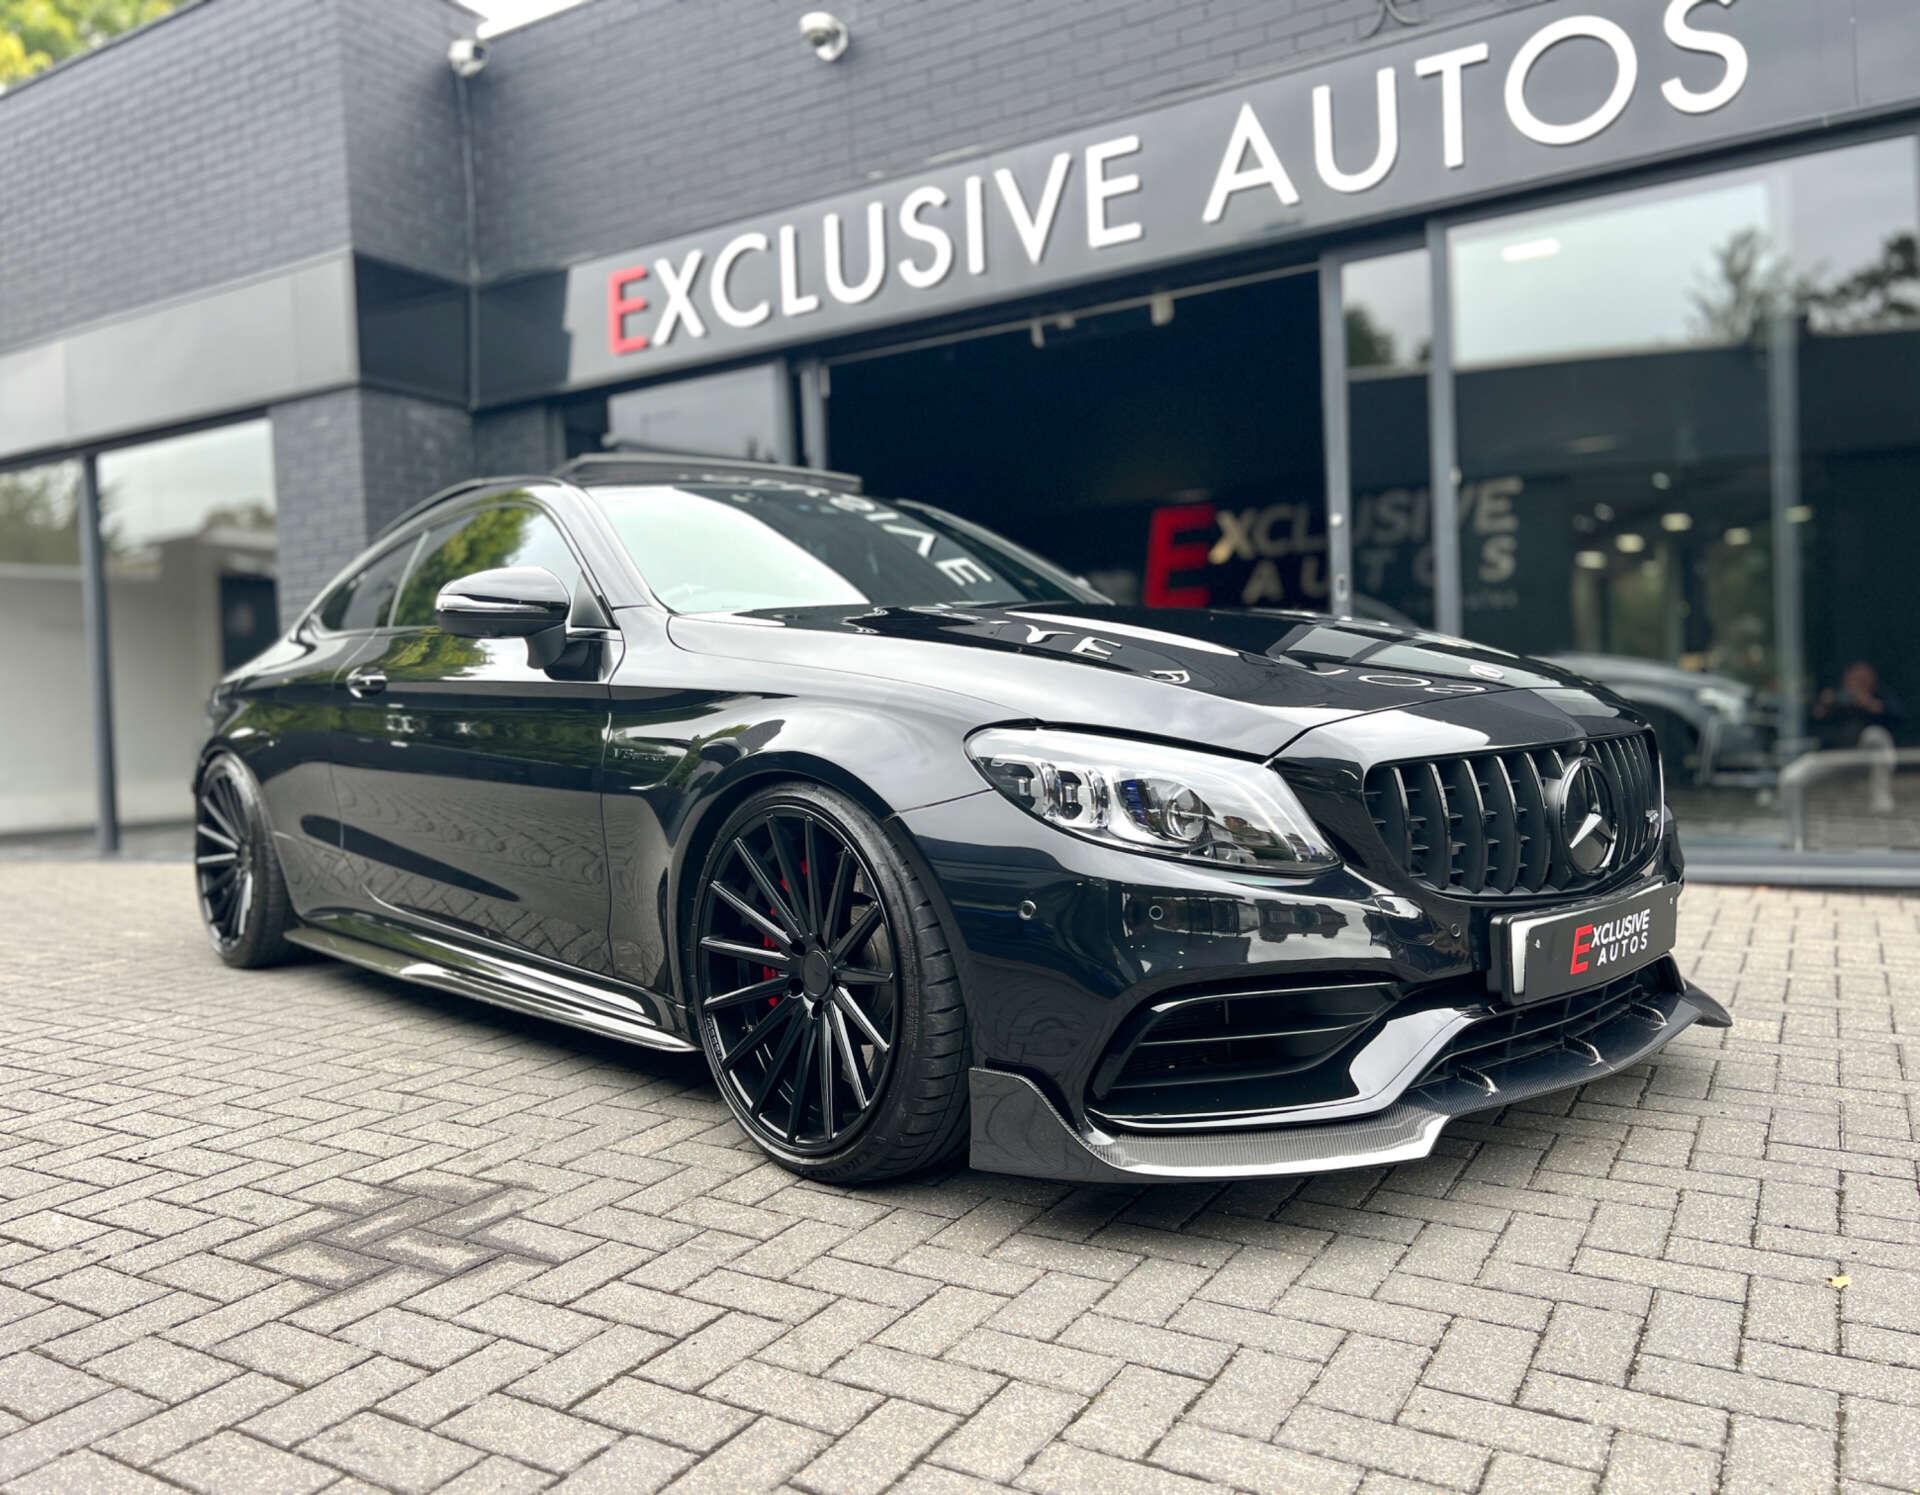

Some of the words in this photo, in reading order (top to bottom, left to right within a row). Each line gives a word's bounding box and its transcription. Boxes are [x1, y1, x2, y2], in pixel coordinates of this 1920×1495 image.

[607, 134, 1143, 356] EXCLUSIVE
[1202, 0, 1749, 223] AUTOS
[1570, 908, 1650, 976] EXCLUSIVE
[1597, 931, 1648, 967] AUTOS
